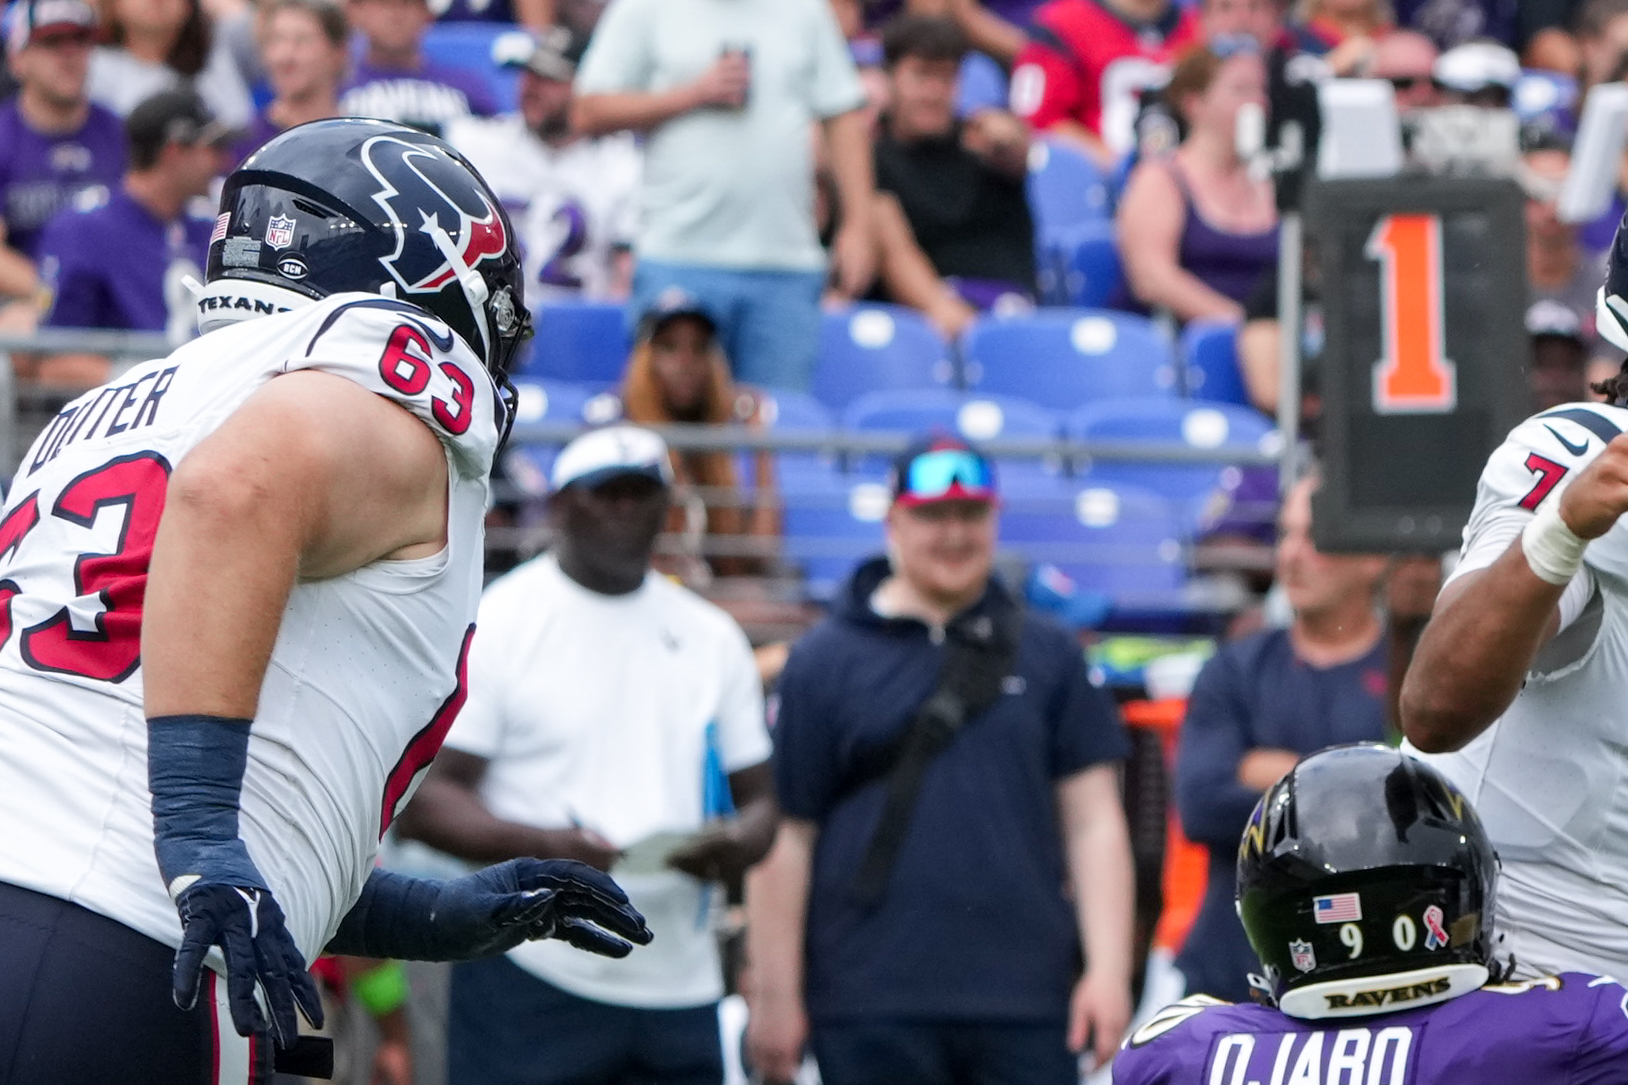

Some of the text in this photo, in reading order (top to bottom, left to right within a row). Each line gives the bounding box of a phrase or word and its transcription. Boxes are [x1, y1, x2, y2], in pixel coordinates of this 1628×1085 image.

[197, 295, 294, 316] TEXAN
[1364, 212, 1457, 415] 1
[378, 324, 475, 436] 63
[1518, 452, 1570, 511] 7
[0, 449, 172, 684] 3
[1323, 976, 1452, 1010] RAVENS
